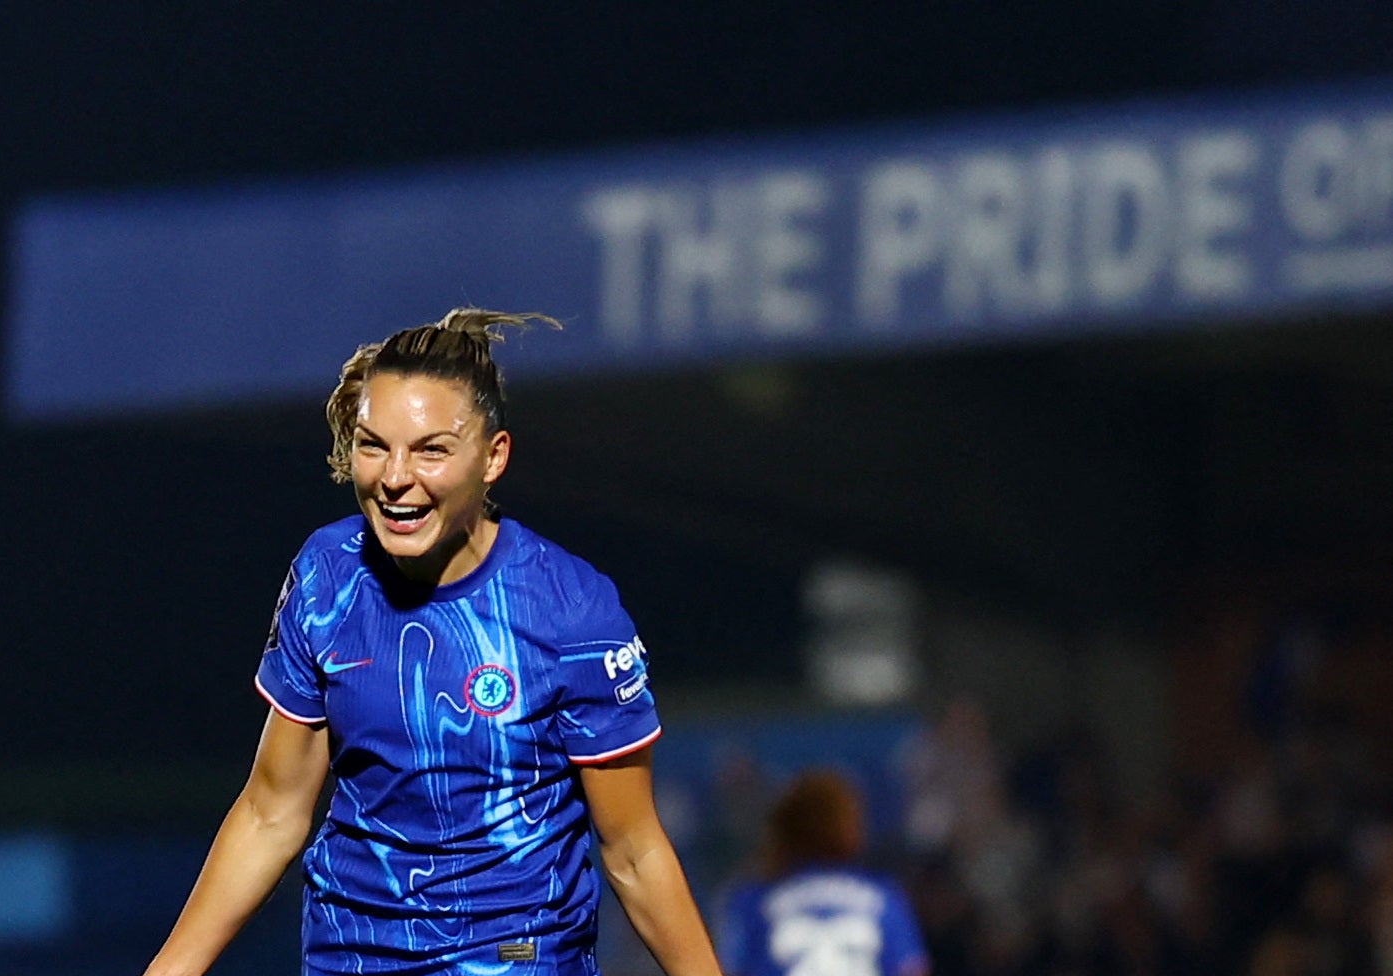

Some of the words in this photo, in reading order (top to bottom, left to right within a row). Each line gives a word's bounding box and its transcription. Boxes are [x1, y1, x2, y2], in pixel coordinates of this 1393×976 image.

[583, 170, 827, 342] THE
[857, 130, 1257, 328] PRIDE
[603, 634, 648, 680] fev
